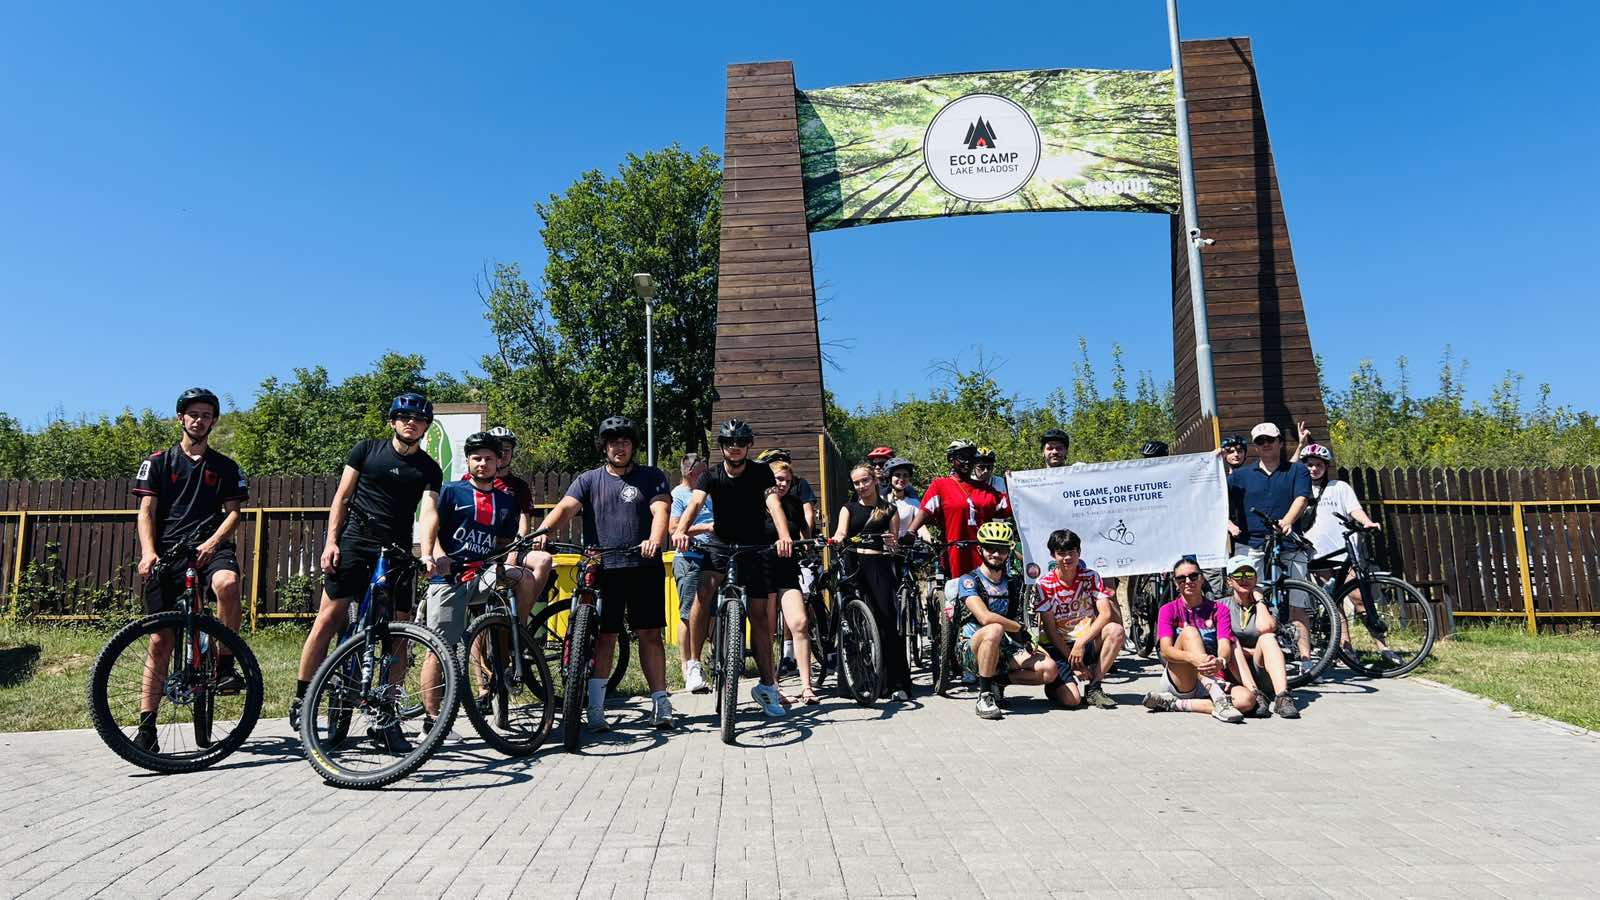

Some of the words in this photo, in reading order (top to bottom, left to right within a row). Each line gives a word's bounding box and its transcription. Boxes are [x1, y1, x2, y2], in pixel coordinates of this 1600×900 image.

[950, 155, 976, 166] ECO
[980, 152, 1019, 164] CAMP
[950, 166, 974, 176] LAKE
[976, 164, 1019, 174] MLADOST
[1062, 489, 1081, 499] ONE
[1083, 487, 1112, 497] GAME,
[1113, 485, 1133, 494] ONE
[1134, 481, 1172, 492] FUTURE:
[1073, 497, 1108, 507] PEDALS
[1109, 495, 1127, 503] FOR
[1128, 492, 1164, 502] FUTURE
